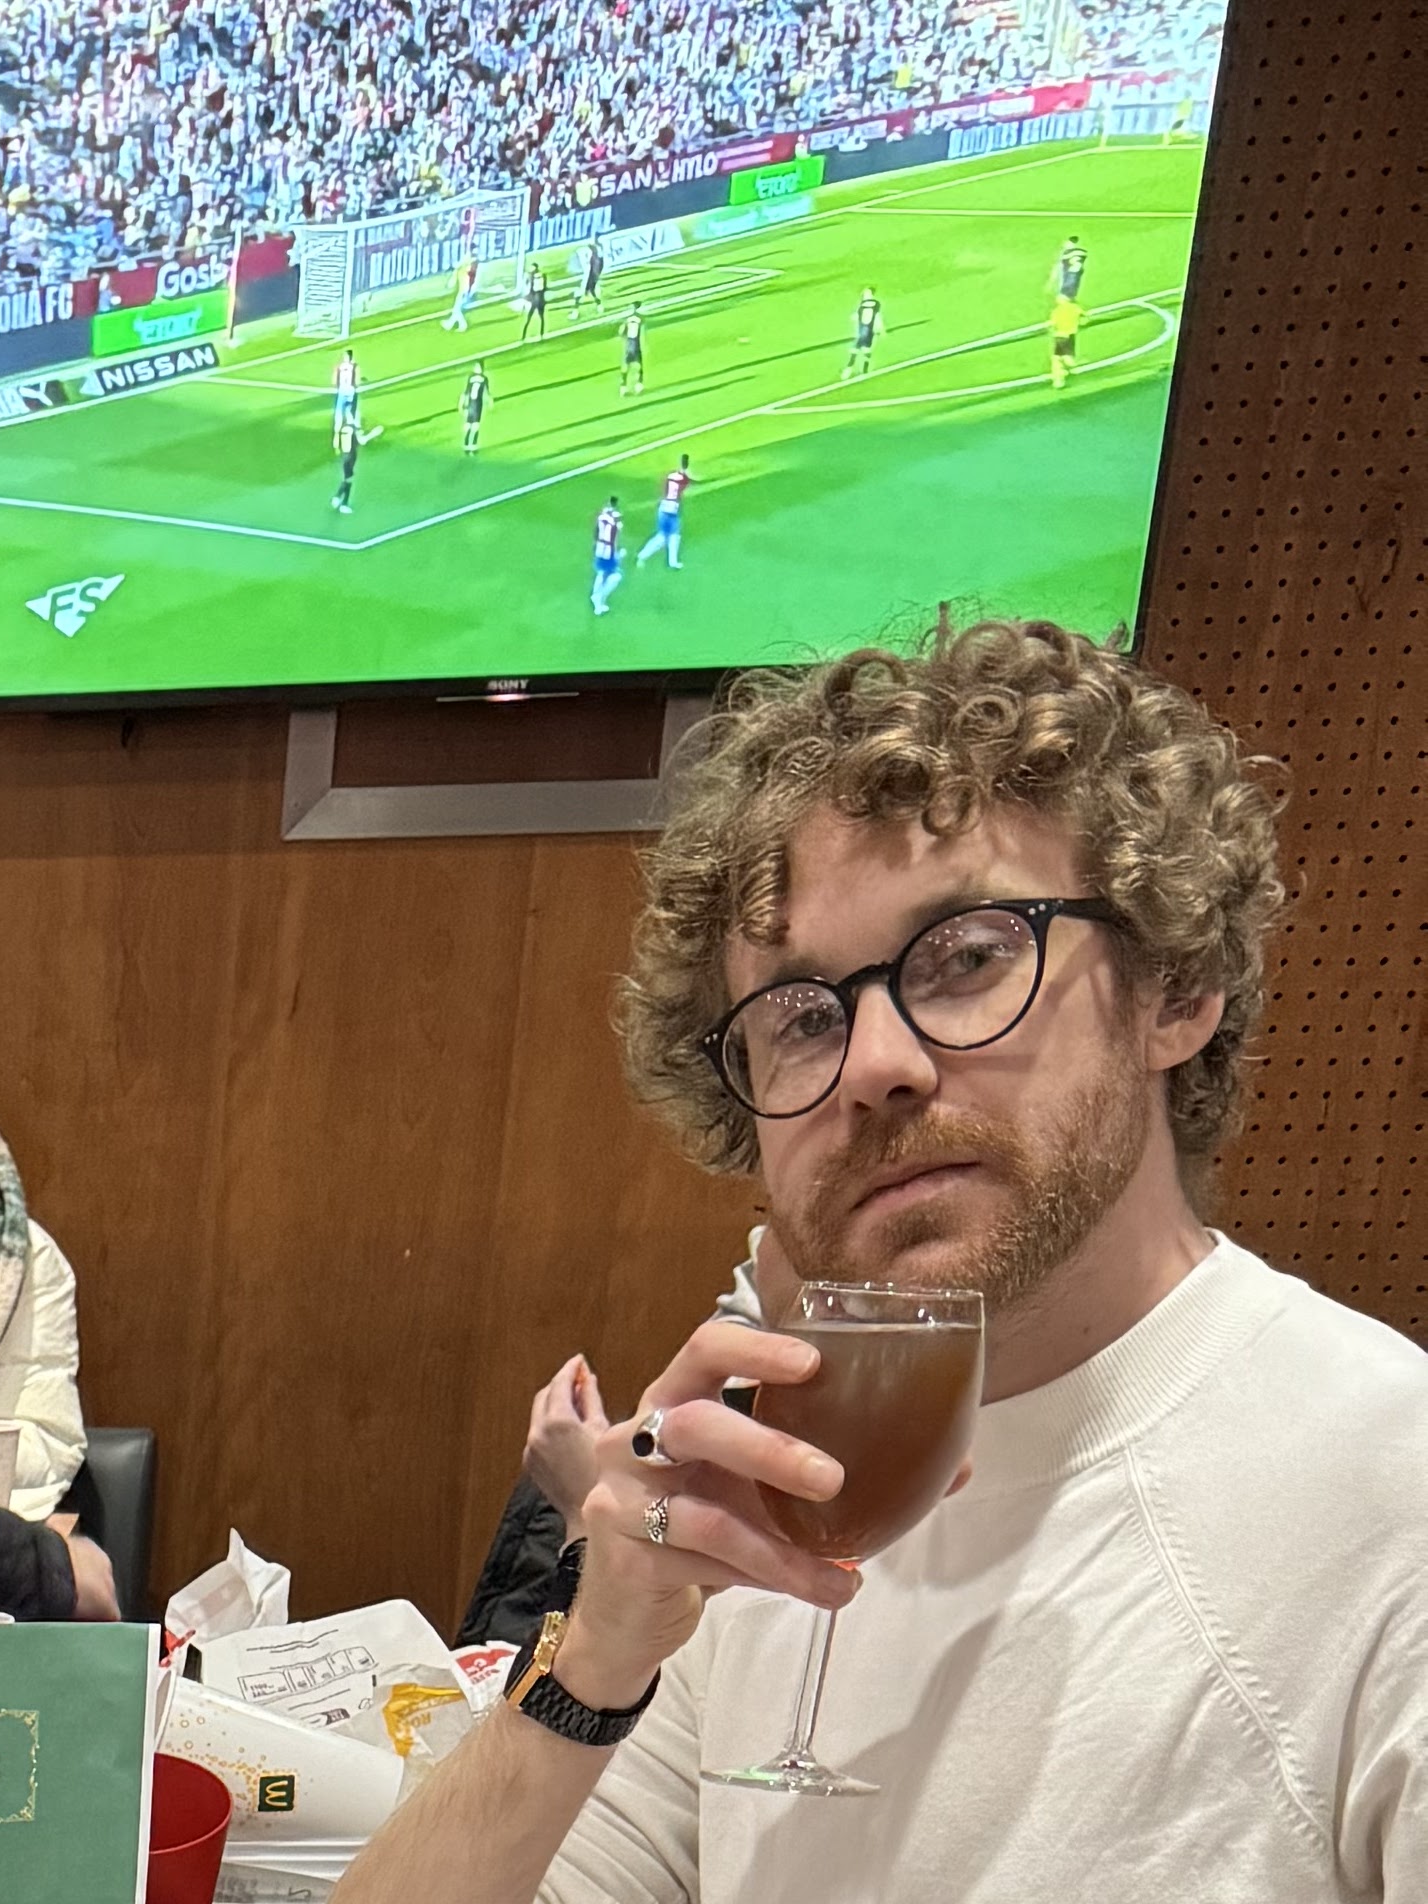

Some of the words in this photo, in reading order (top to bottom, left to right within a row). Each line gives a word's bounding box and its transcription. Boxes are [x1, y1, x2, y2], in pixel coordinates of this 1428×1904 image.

[45, 282, 74, 323] FC
[101, 346, 215, 390] NISSAN
[487, 679, 530, 691] SONY
